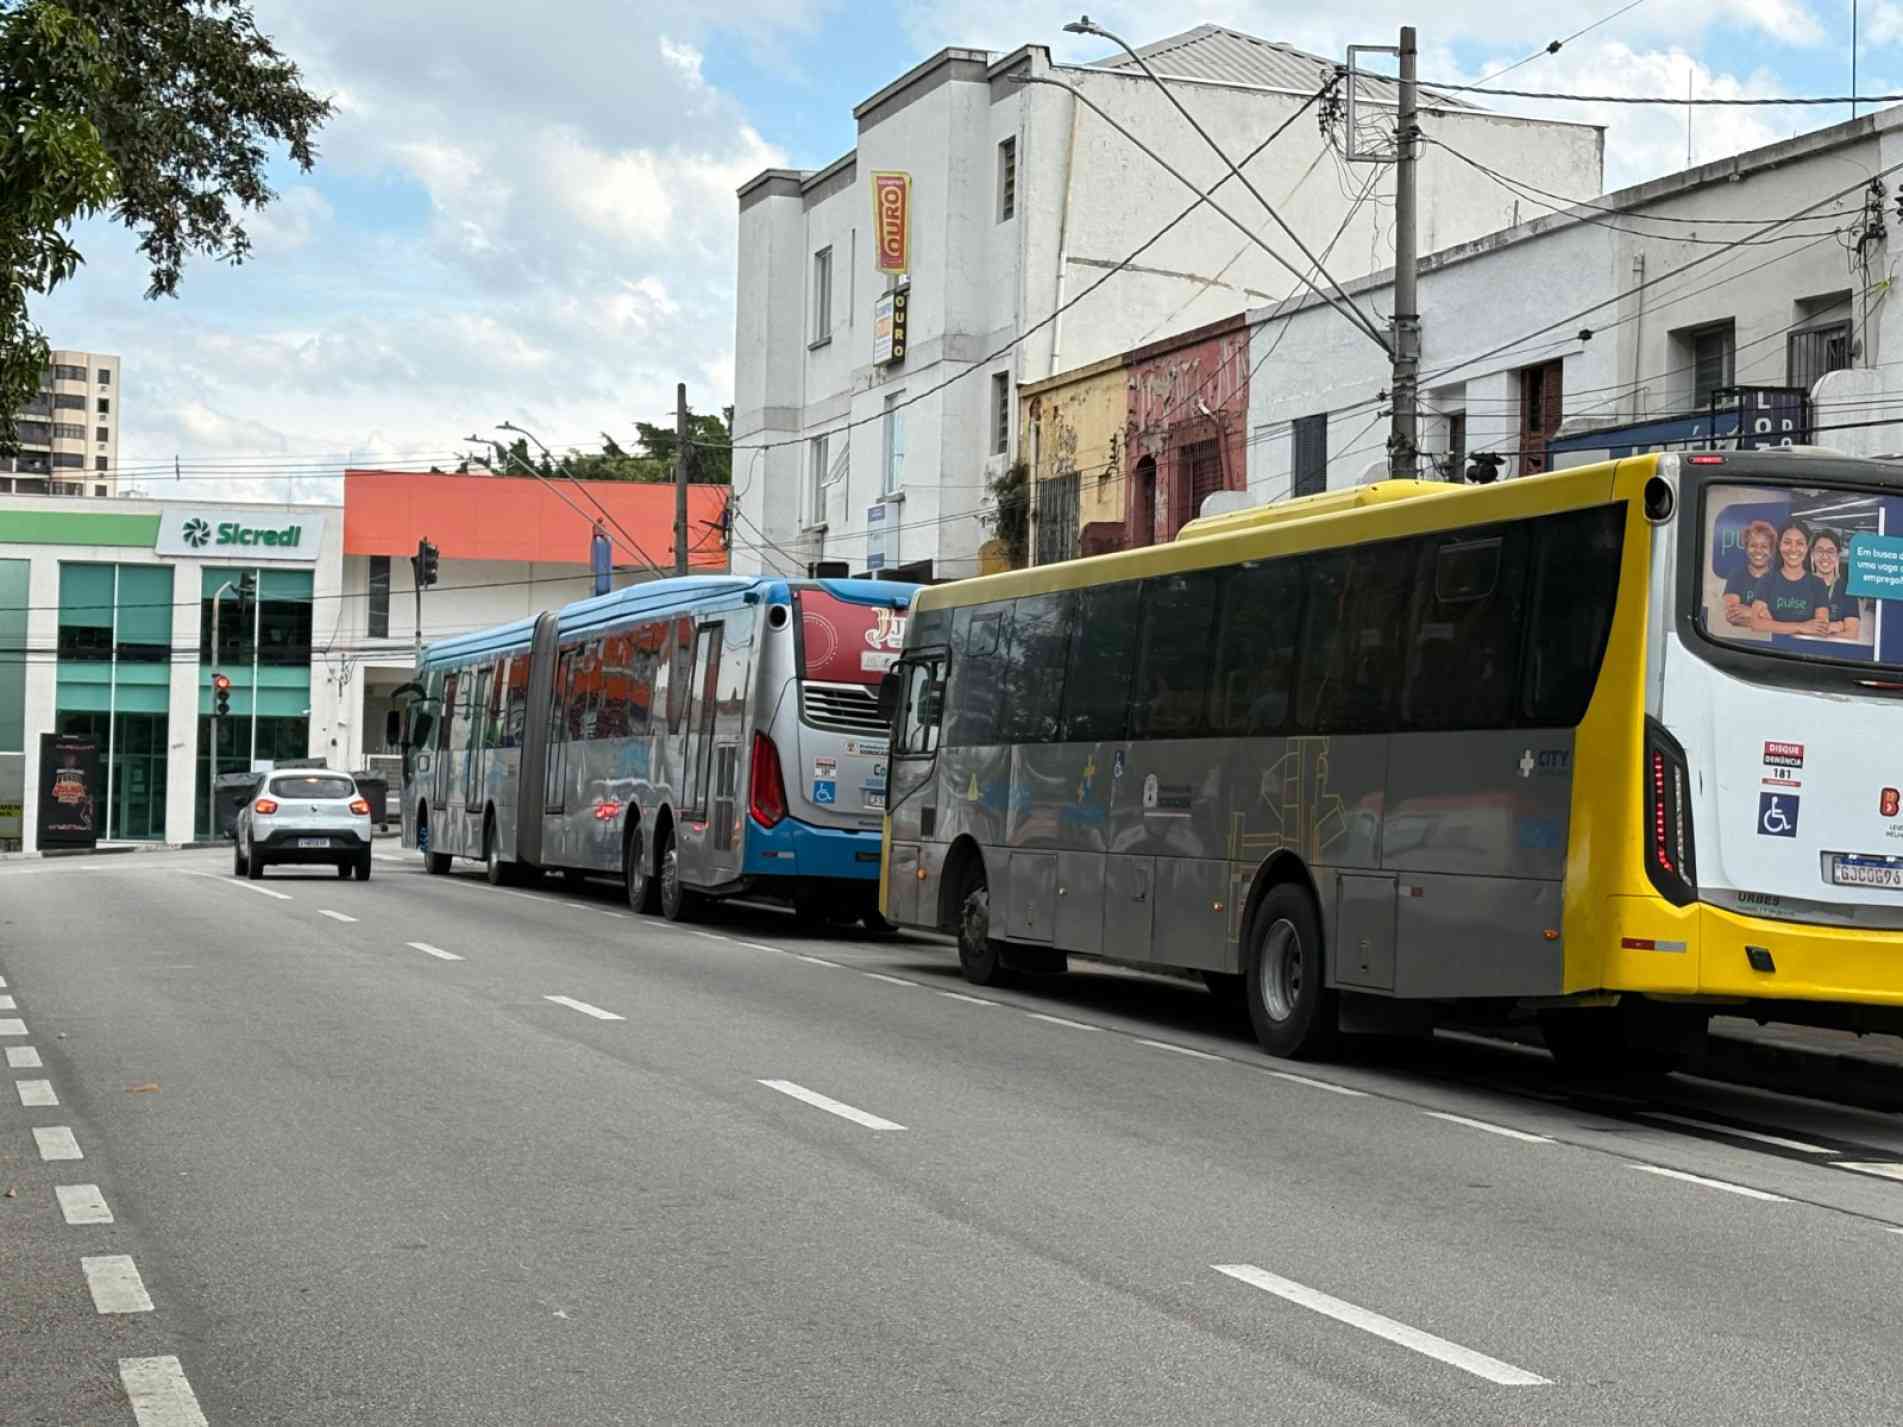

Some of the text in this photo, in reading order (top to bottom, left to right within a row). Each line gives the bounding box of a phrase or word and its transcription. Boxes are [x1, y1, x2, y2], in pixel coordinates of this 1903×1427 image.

[882, 187, 901, 255] OURO
[894, 295, 905, 357] OURO
[216, 522, 301, 547] Sicredi
[1857, 547, 1871, 556] Em
[1873, 547, 1898, 560] busca
[1857, 561, 1876, 570] uma
[1878, 563, 1898, 573] vaga
[1776, 596, 1808, 609] pulse
[1769, 744, 1800, 756] DISQUE
[1773, 767, 1791, 779] 181
